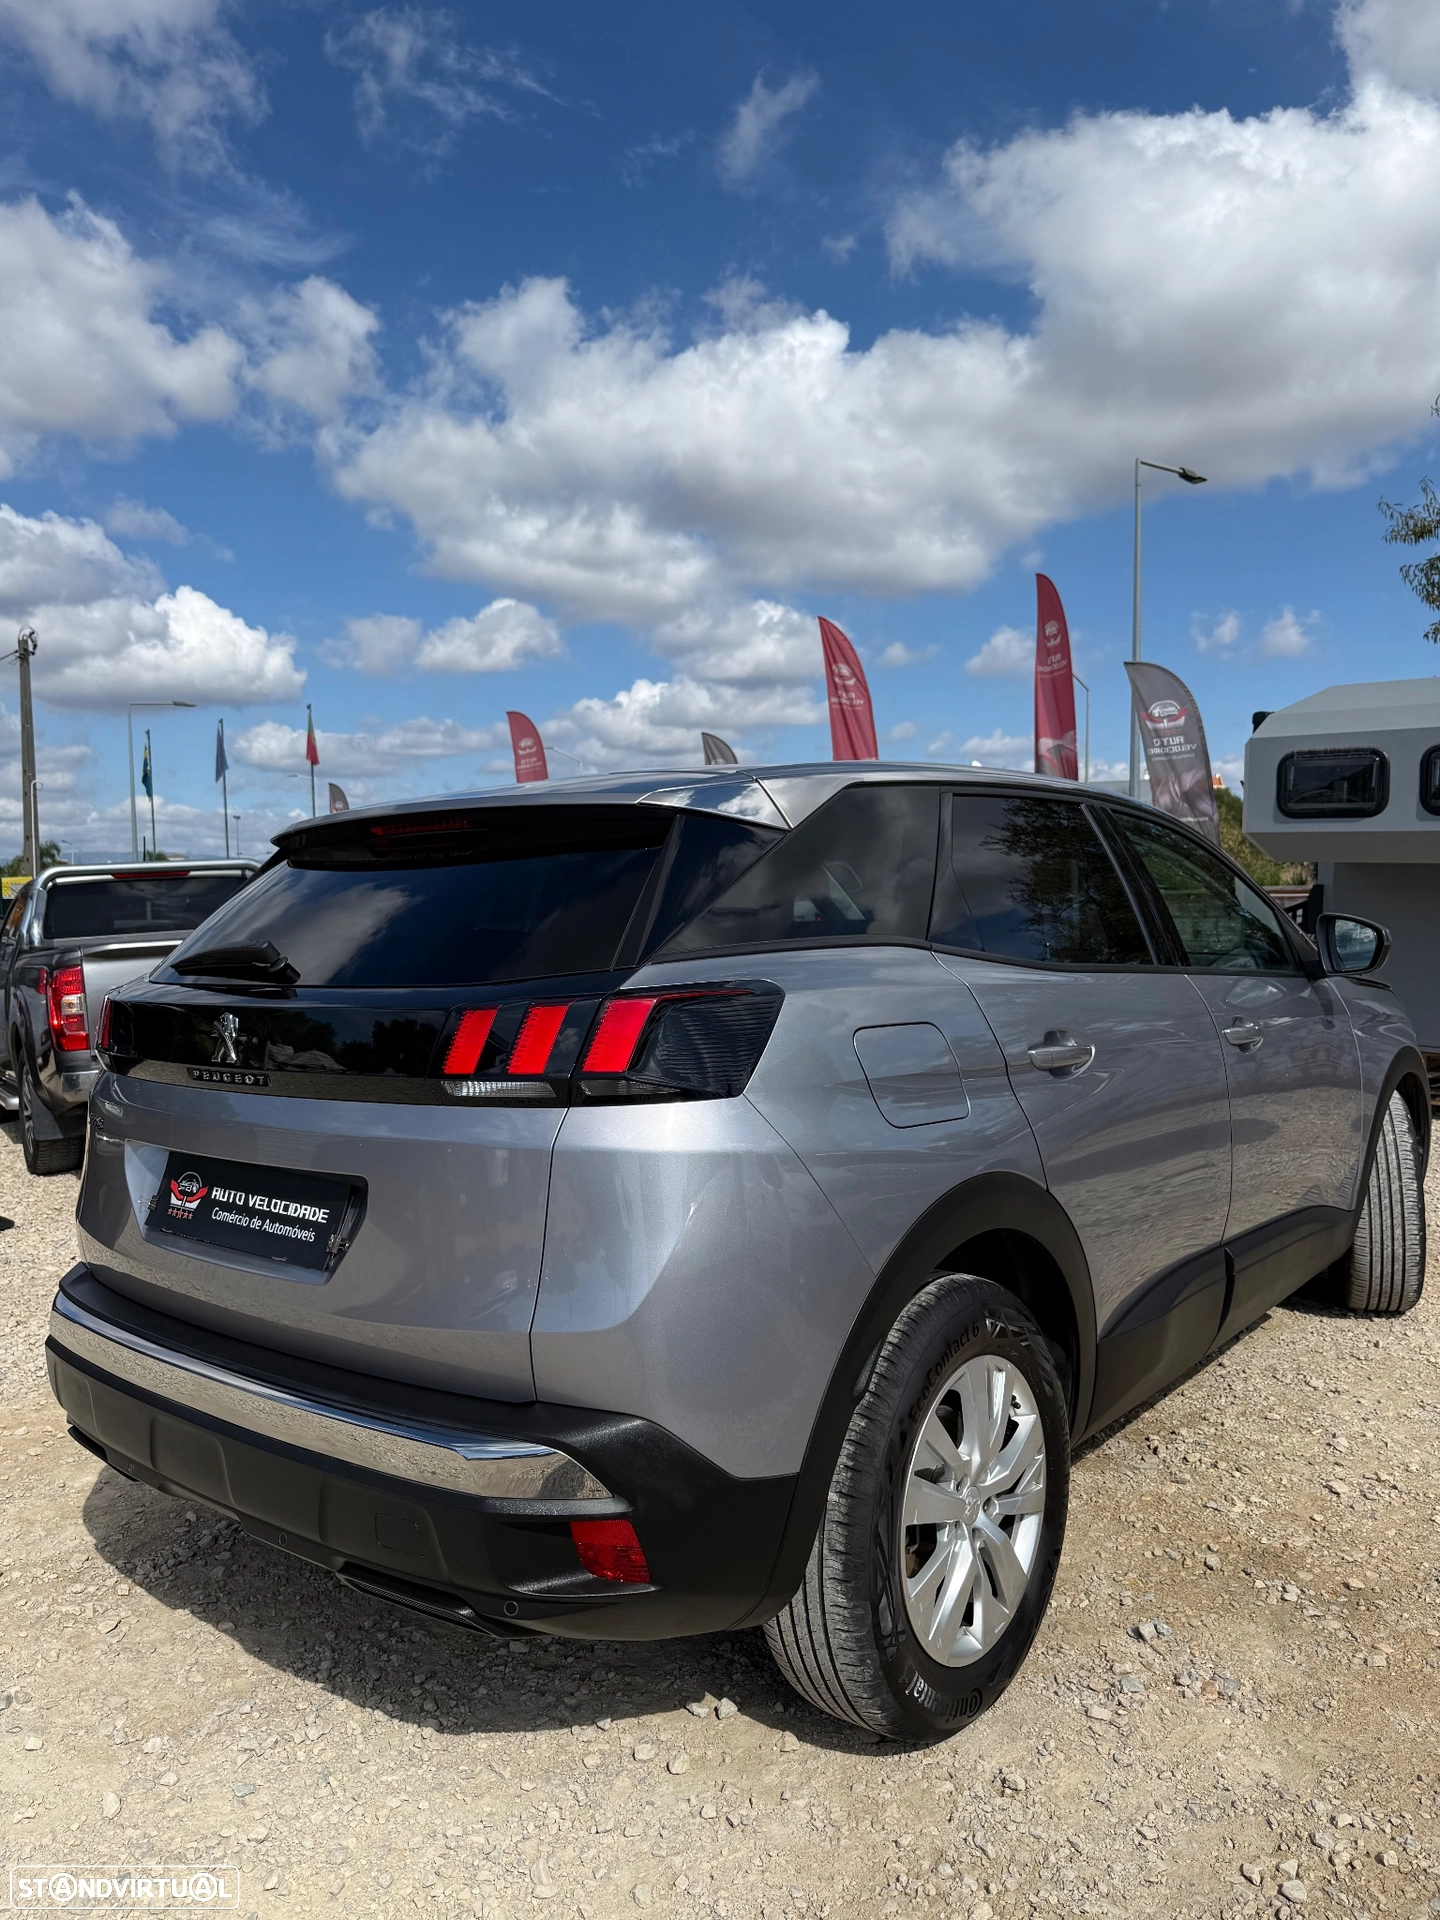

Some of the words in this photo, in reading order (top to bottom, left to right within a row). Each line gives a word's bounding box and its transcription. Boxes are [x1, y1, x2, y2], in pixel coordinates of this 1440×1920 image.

[192, 1070, 265, 1085] PEUGEOT
[211, 1186, 245, 1206] AUTO
[248, 1194, 331, 1224] VELOCIDADE
[212, 1207, 250, 1227] Comércio
[250, 1215, 262, 1230] de
[262, 1219, 316, 1242] Automóveis
[909, 1325, 970, 1424] EcoContact
[972, 1319, 981, 1338] 6
